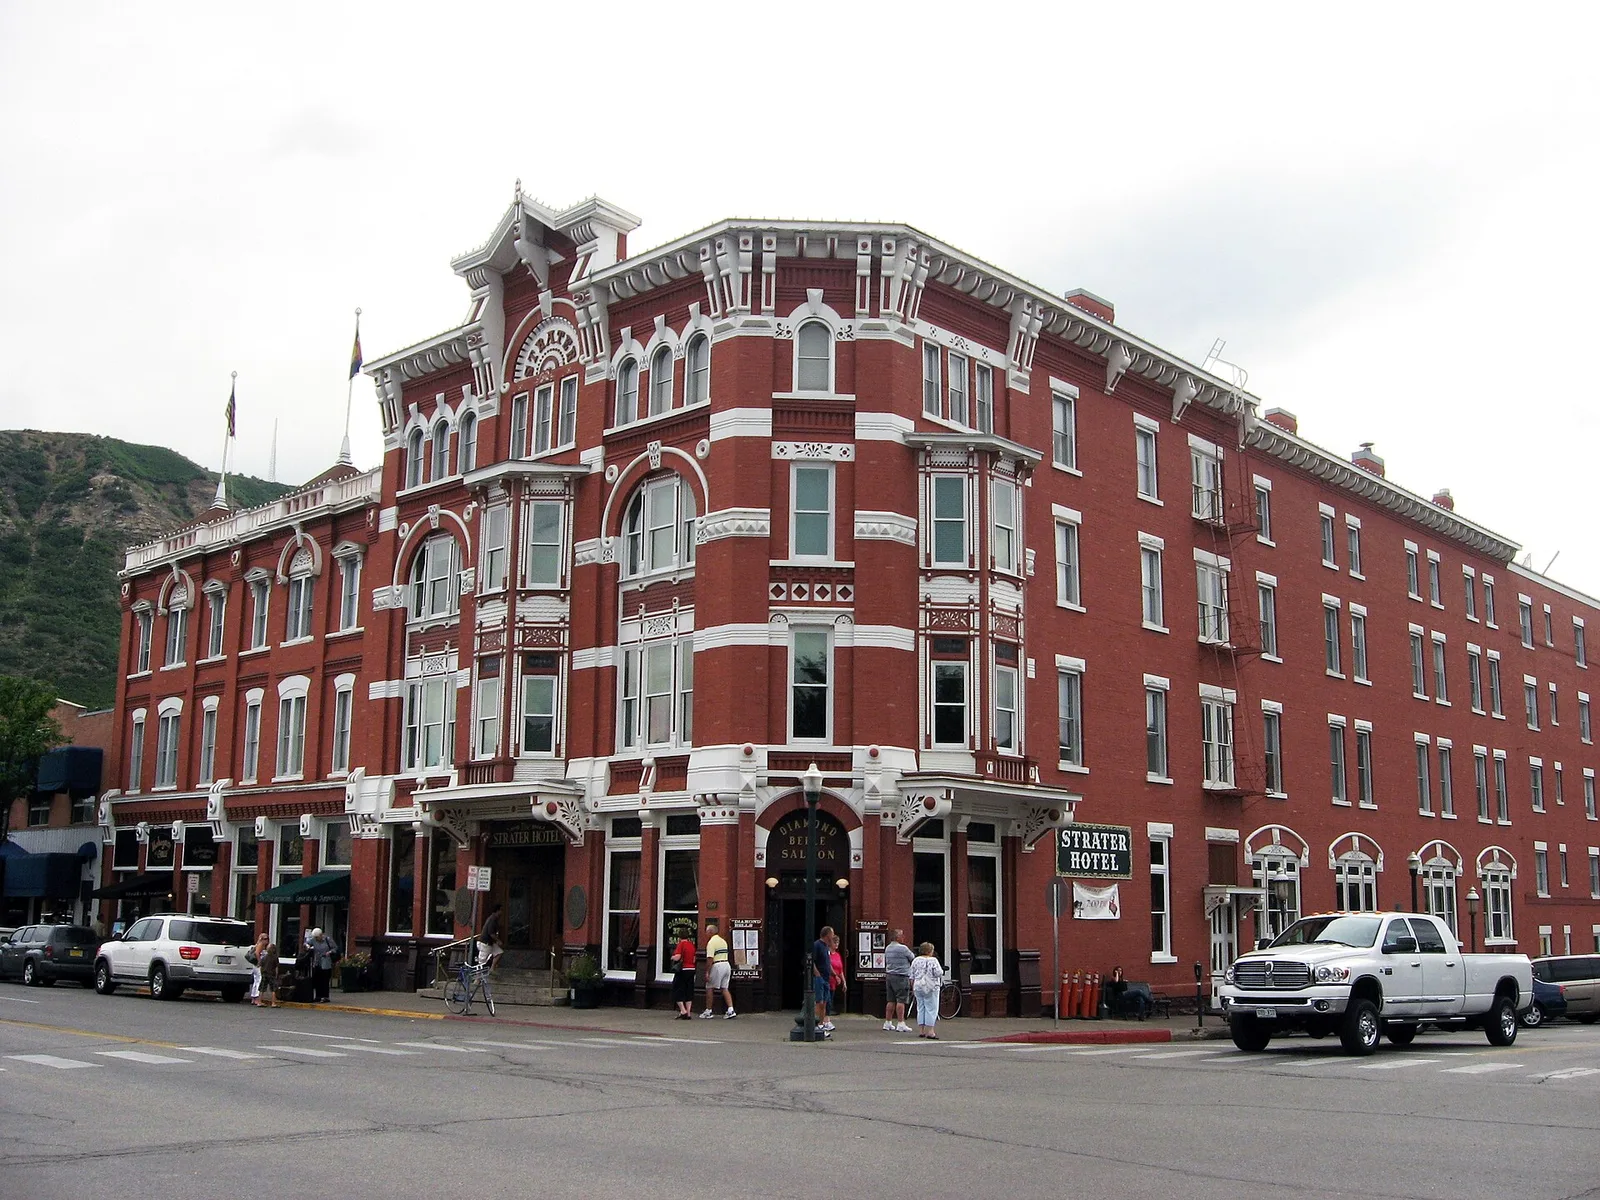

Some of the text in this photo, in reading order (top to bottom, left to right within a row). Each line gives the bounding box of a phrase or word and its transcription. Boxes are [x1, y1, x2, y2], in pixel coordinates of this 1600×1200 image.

[524, 330, 577, 377] STRATER
[492, 829, 560, 845] STRATER HOTEL
[1061, 829, 1128, 852] STRATER
[781, 849, 836, 860] SALON
[1070, 851, 1119, 871] HOTEL
